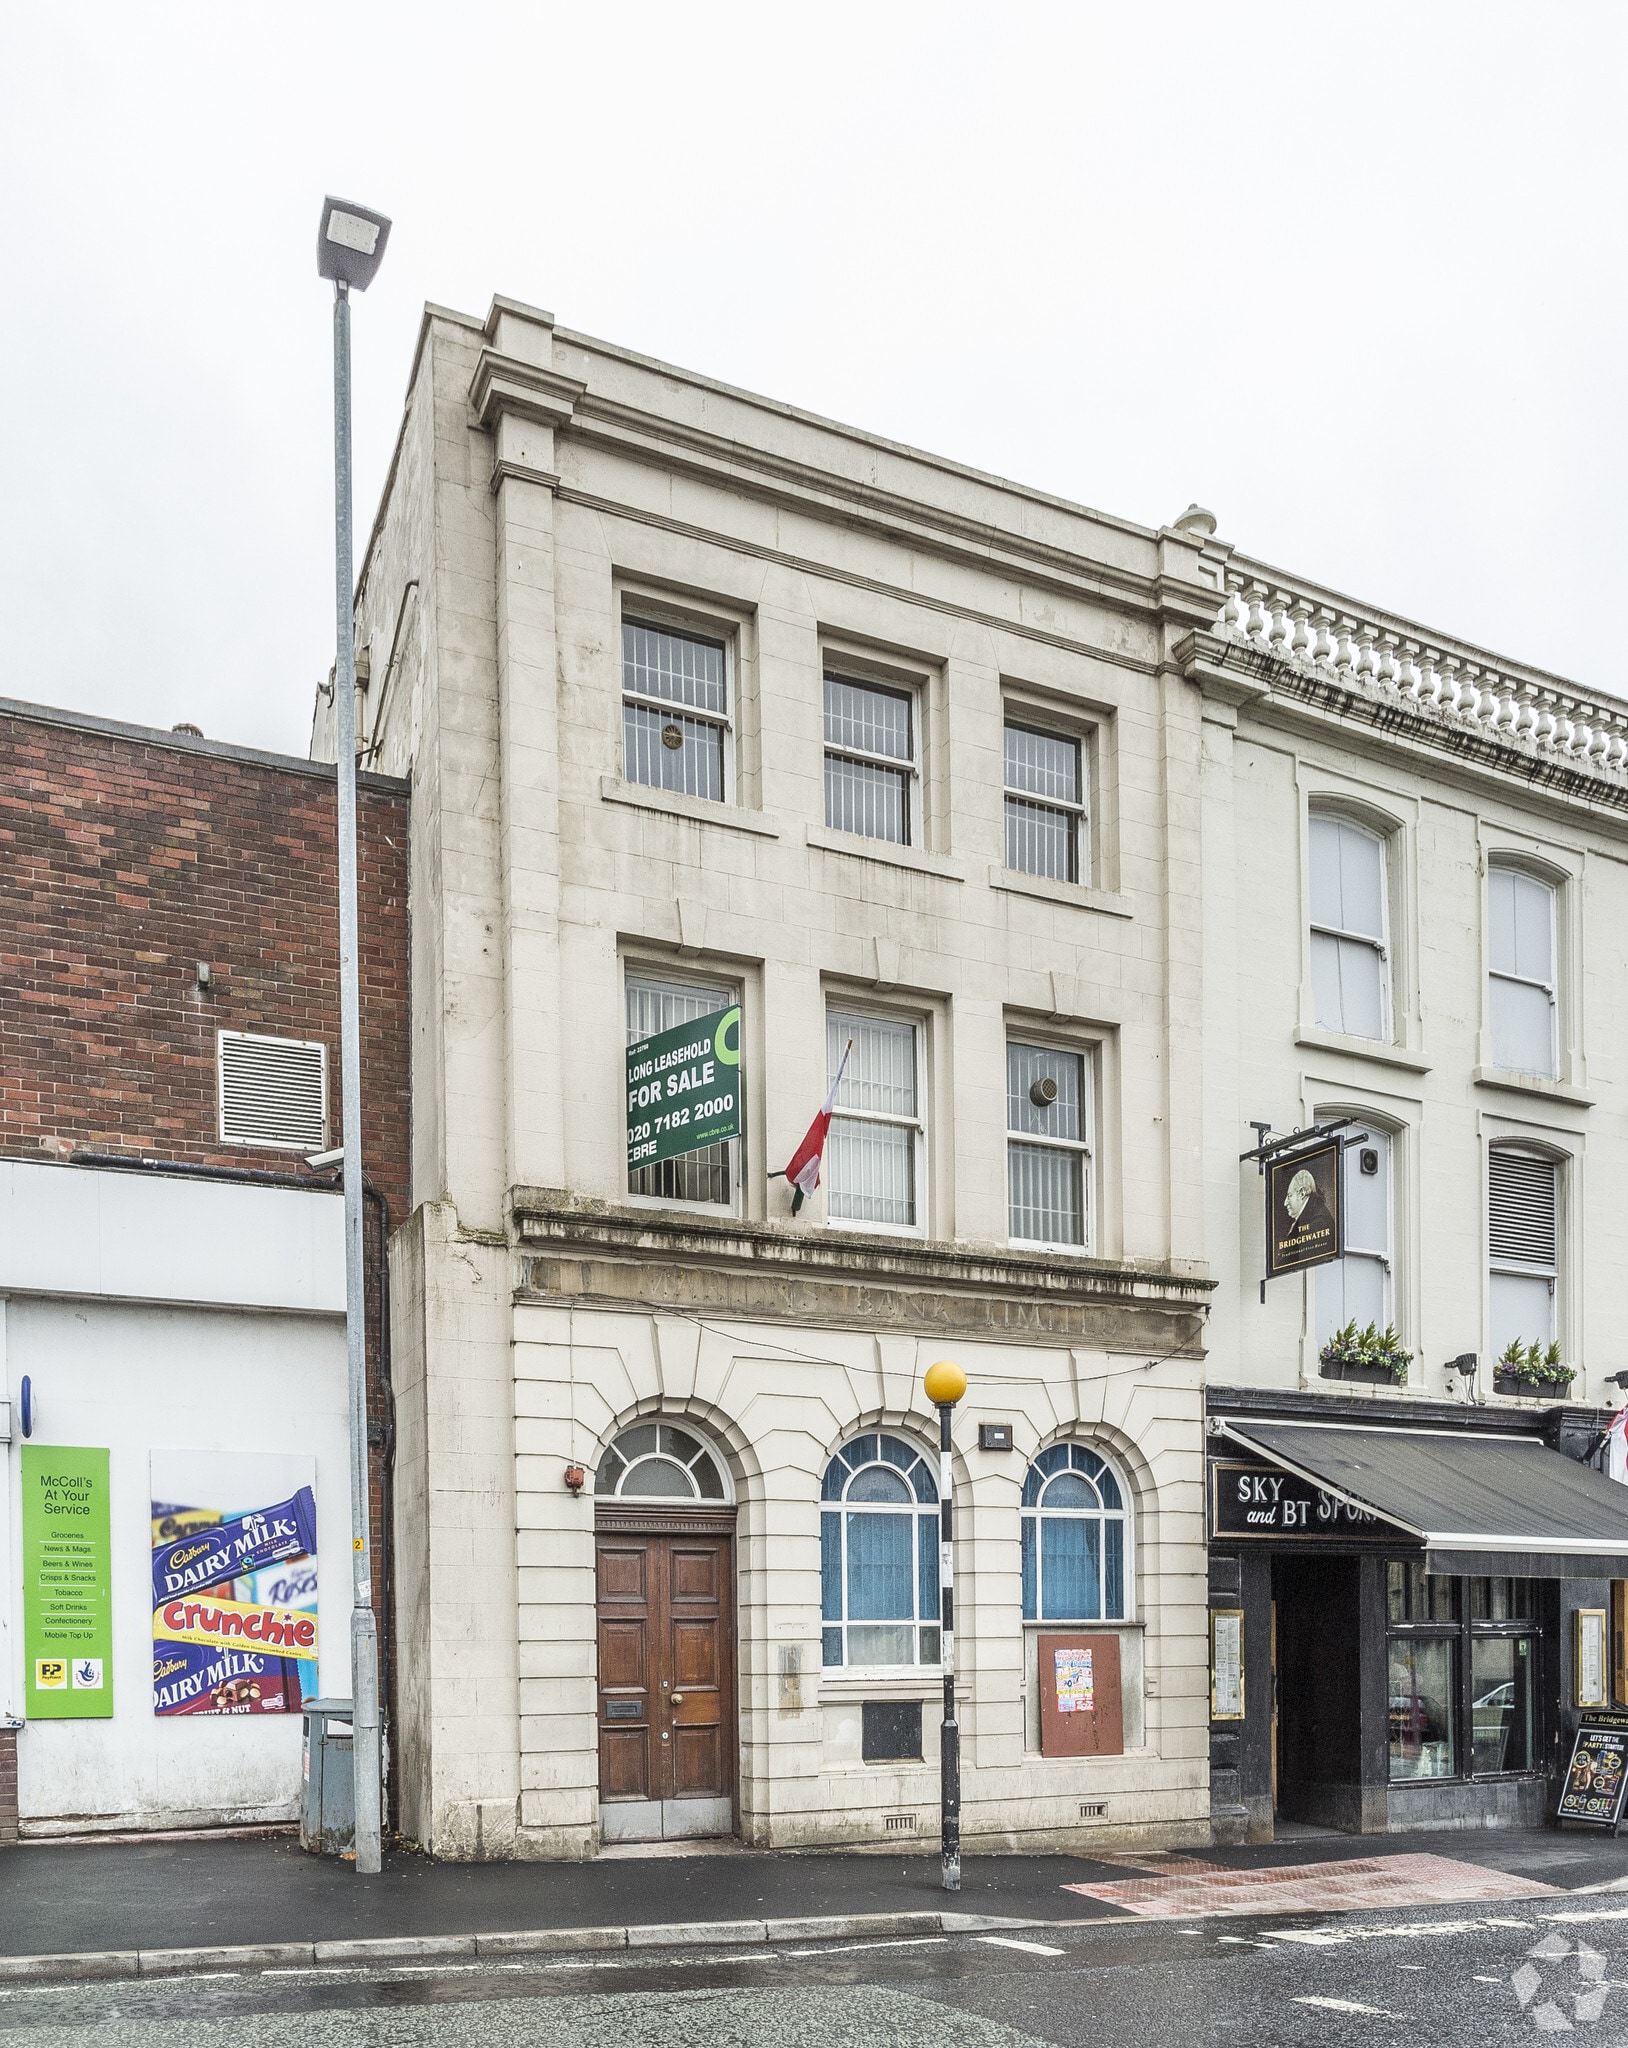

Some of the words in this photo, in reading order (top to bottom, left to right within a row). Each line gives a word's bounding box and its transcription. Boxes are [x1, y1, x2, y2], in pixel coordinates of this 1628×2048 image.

[628, 1060, 653, 1083] LONG
[654, 1038, 711, 1073] LEASEHOLD
[628, 1080, 662, 1112] FOR
[666, 1060, 715, 1097] SALE
[627, 1122, 651, 1144] 020
[654, 1108, 690, 1134] 7182
[694, 1094, 734, 1121] 2000
[696, 1123, 735, 1140] www.cbre.co.uk
[1298, 1224, 1310, 1232] THE
[1278, 1228, 1331, 1250] BRIDGEWATER
[40, 1475, 93, 1489] McColl's
[1237, 1475, 1285, 1503] SKY
[44, 1489, 57, 1500] At
[61, 1489, 90, 1501] Your
[44, 1502, 90, 1515] Service
[1246, 1506, 1277, 1525] and
[1281, 1500, 1311, 1527] BT
[51, 1531, 84, 1539] Groceries
[72, 1545, 91, 1554] Mags
[354, 1540, 361, 1550] 2
[164, 1545, 232, 1592] DAIRY
[234, 1518, 297, 1558] MILK
[170, 1542, 210, 1570] Cadbury
[71, 1560, 93, 1568] Wines
[40, 1573, 62, 1581] Crisps
[45, 1617, 93, 1625] Confectionery
[163, 1601, 315, 1647] Crunchie
[44, 1631, 68, 1639] Mobile
[69, 1632, 81, 1640] Top
[153, 1658, 188, 1682] Cadbury
[206, 1653, 265, 1687] MILK
[231, 1703, 251, 1714] NUT
[1584, 1713, 1597, 1722] The
